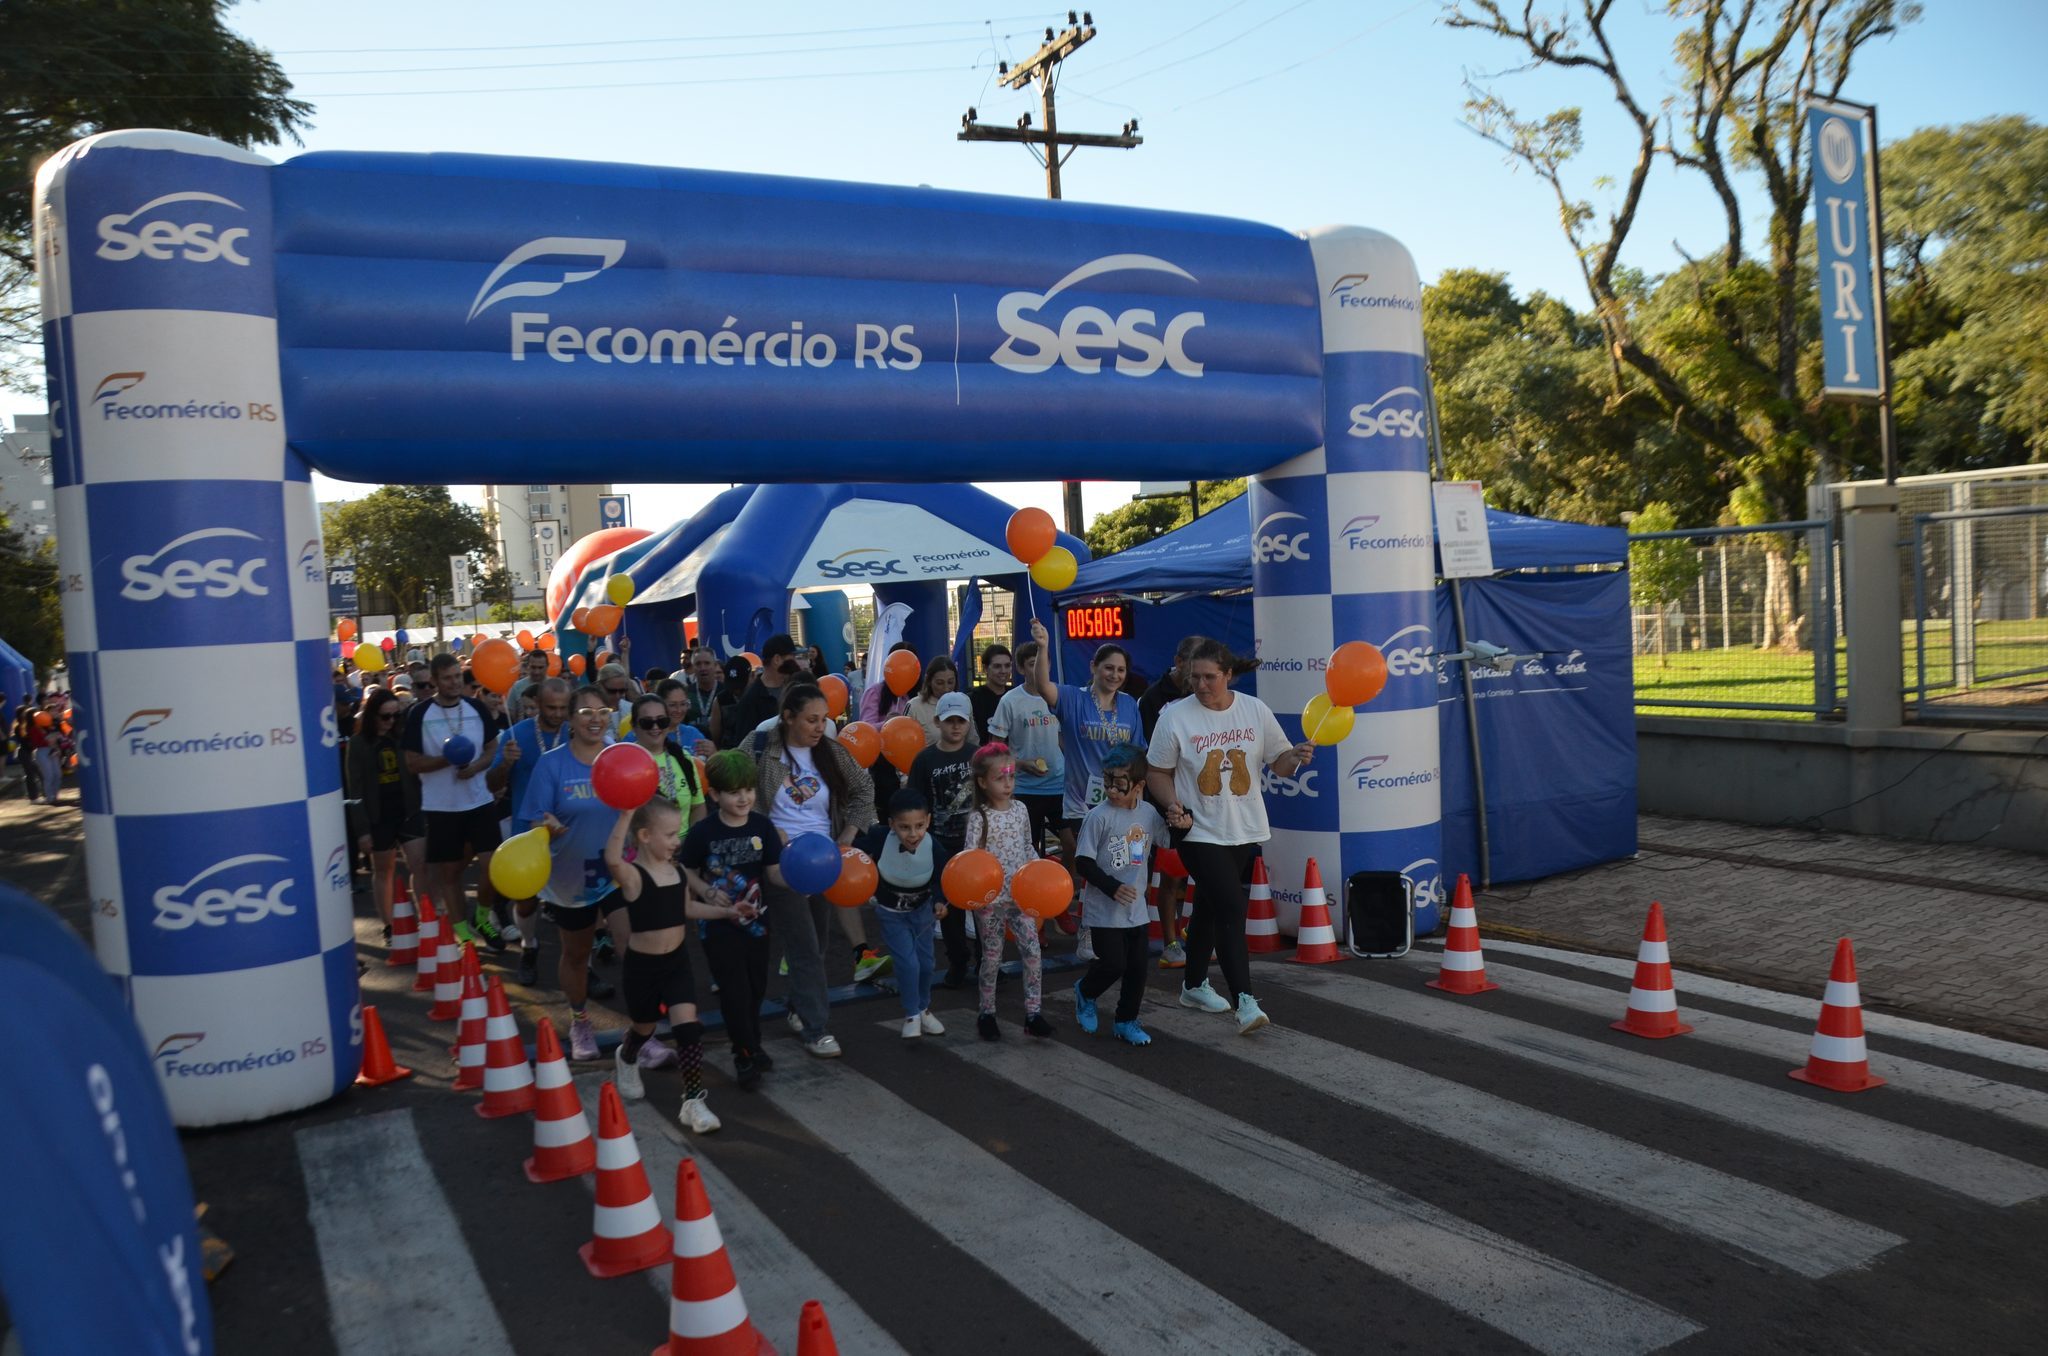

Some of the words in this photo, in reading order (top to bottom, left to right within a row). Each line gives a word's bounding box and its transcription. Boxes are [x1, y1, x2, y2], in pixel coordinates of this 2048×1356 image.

[1825, 197, 1864, 384] URI
[510, 311, 837, 368] Fecomércio
[854, 322, 923, 371] RS
[990, 290, 1206, 378] Sesc
[103, 400, 241, 421] Fecomércio
[248, 403, 277, 422] RS
[912, 548, 991, 564] Fecomércio
[1350, 534, 1425, 551] Fecomércio
[1067, 606, 1124, 638] 005805
[130, 731, 264, 756] Fecomércio
[269, 726, 297, 747] RS
[1195, 727, 1256, 754] CAPYBARAS
[1357, 769, 1432, 790] Fecomércio
[164, 1047, 297, 1077] Fecomércio
[300, 1036, 328, 1060] RS
